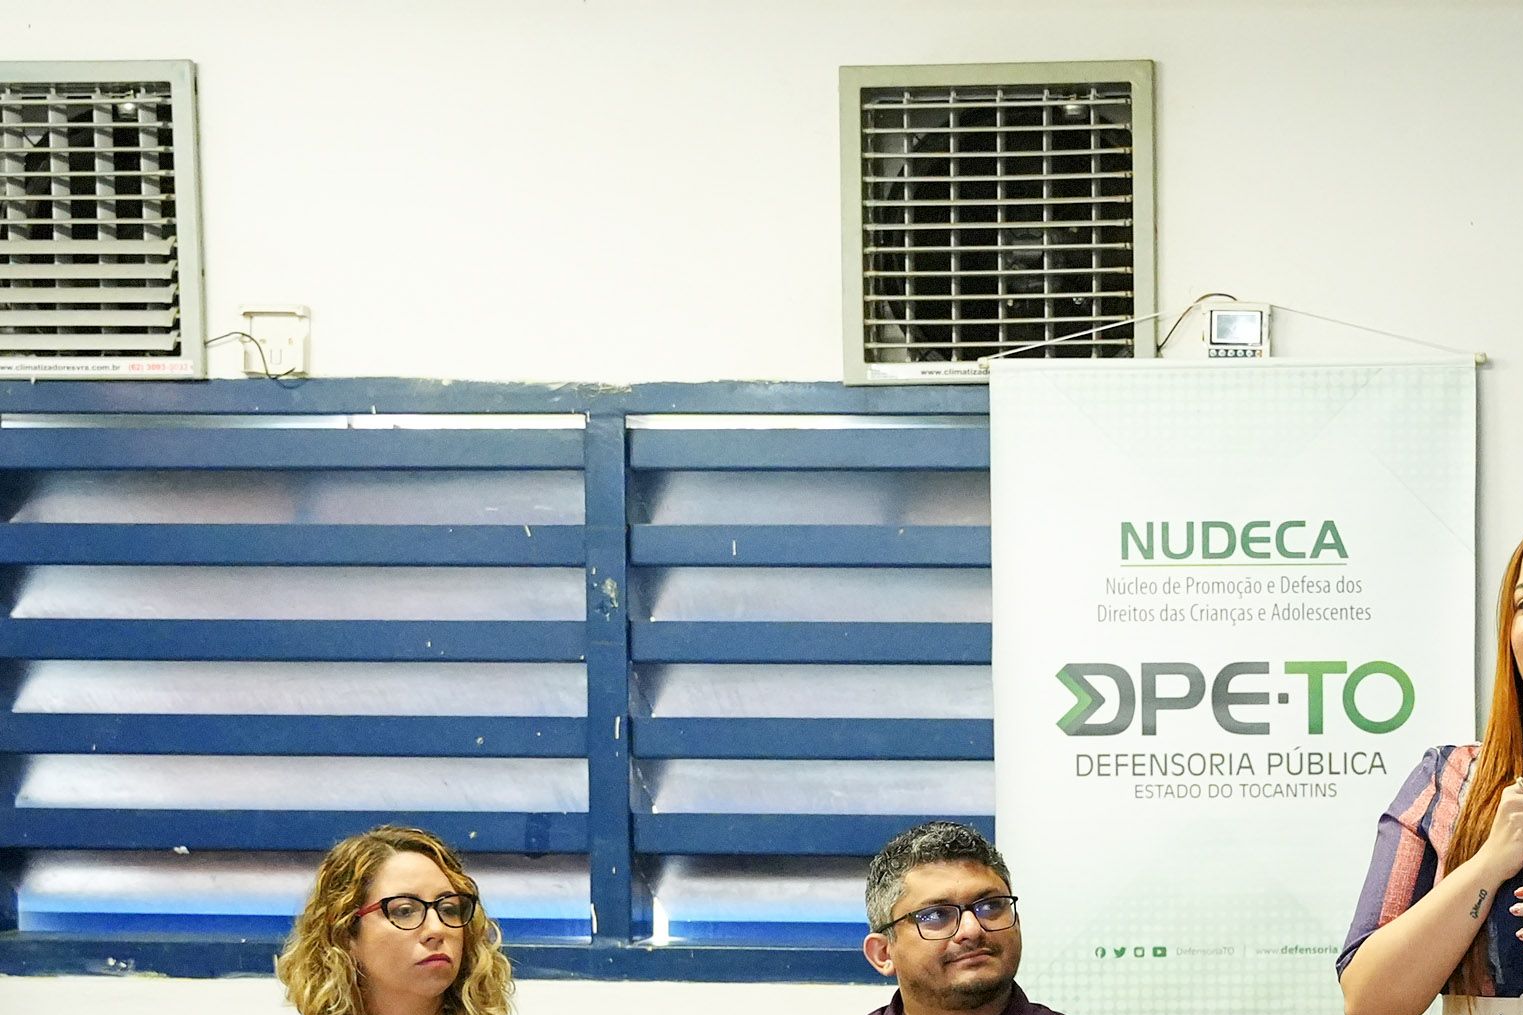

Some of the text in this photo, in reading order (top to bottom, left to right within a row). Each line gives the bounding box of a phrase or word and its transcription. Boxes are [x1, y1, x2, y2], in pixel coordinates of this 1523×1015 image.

[1121, 520, 1349, 560] NUDECA
[1106, 575, 1362, 599] Núcleo de Promoção e Defesa dos
[1098, 603, 1371, 626] Direitos das Crianças e Adolescentes
[1077, 747, 1387, 776] DEFENSORIA PÚBLICA
[1135, 783, 1337, 798] ESTADO DO TOCANTINS
